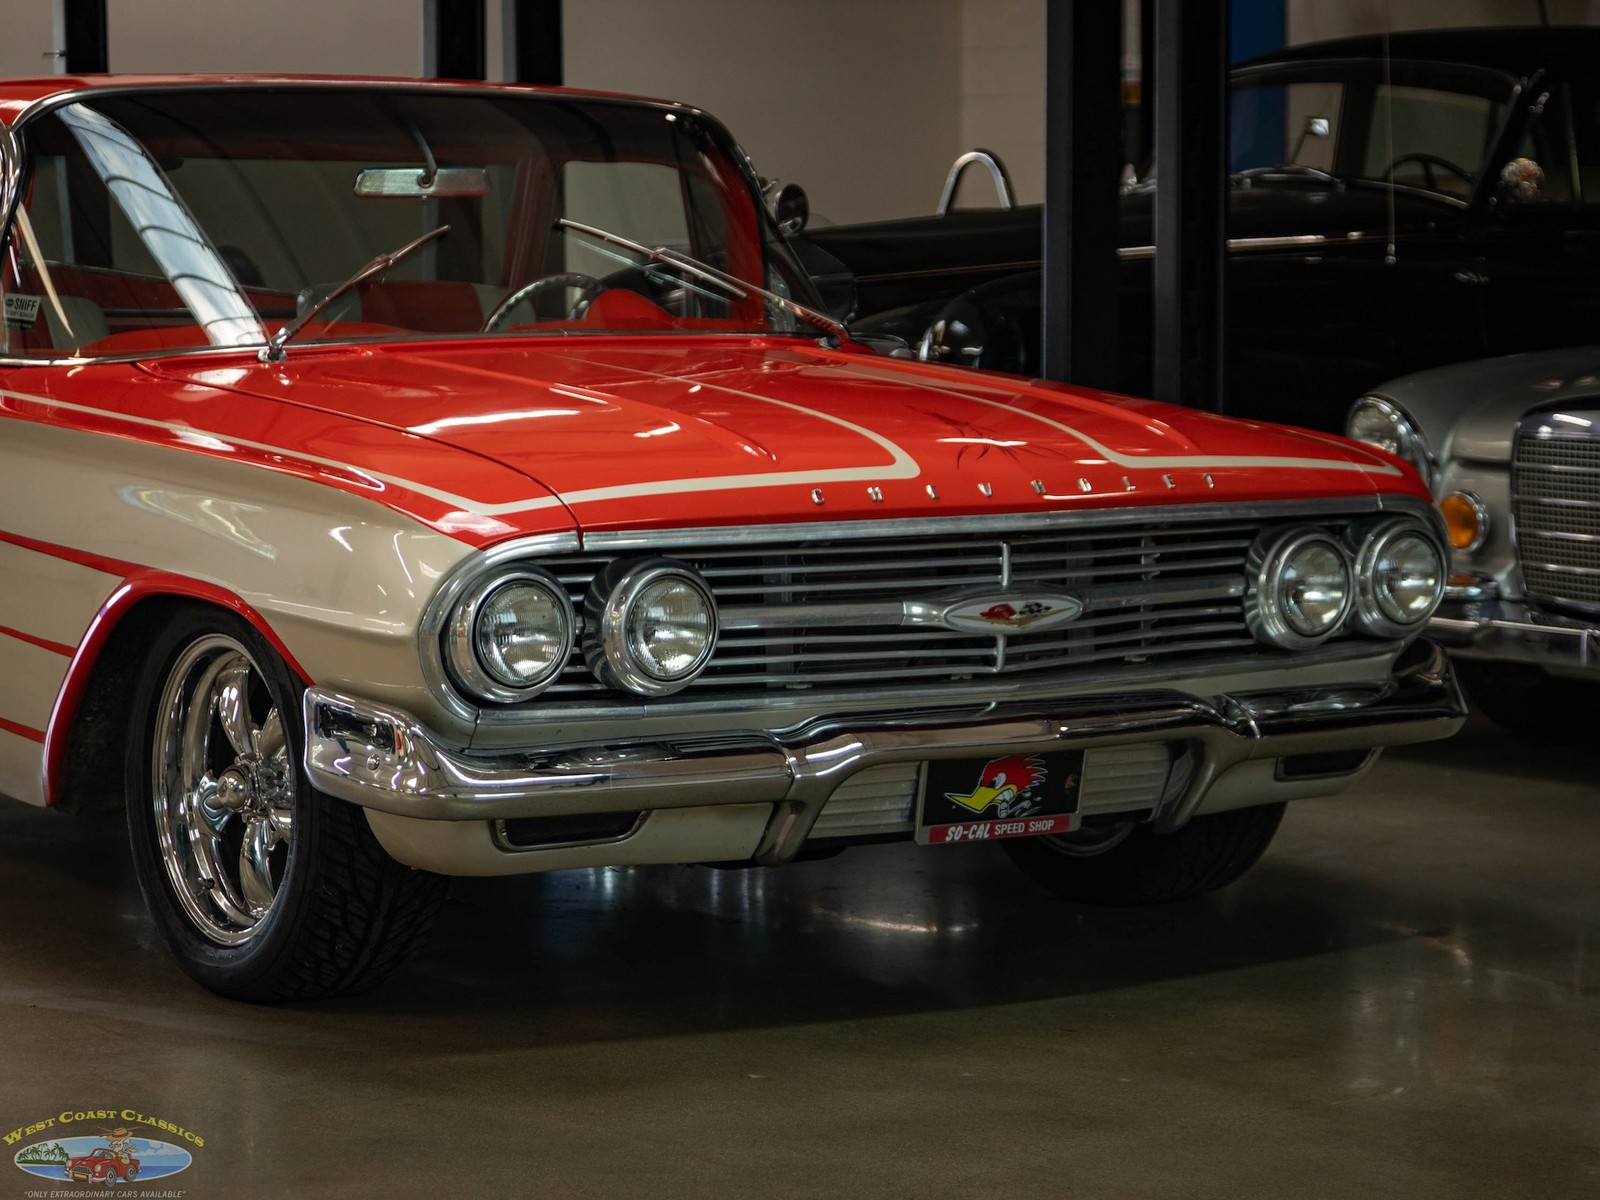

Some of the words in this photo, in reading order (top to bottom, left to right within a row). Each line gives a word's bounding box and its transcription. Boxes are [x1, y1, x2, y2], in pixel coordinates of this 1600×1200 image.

[14, 297, 37, 312] SNIFF
[945, 823, 991, 842] SO-CAL
[994, 822, 1025, 836] SPEED
[1028, 819, 1055, 832] SHOP
